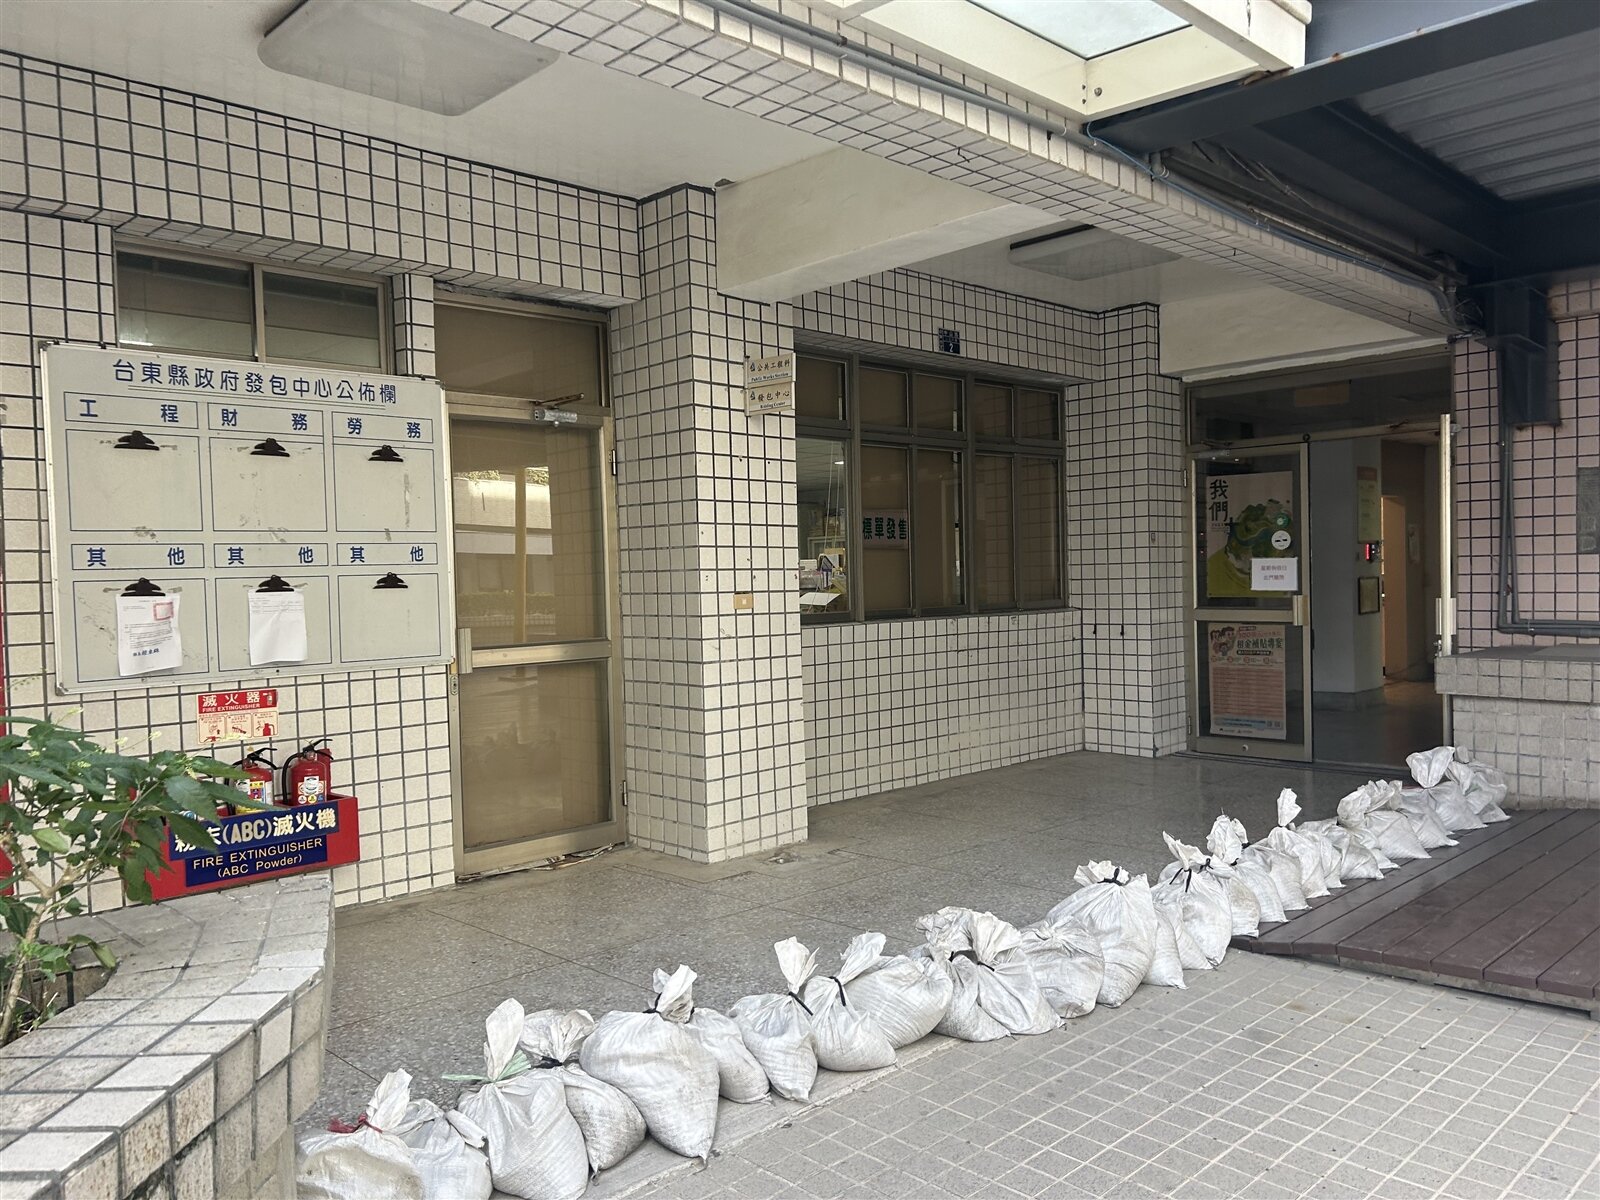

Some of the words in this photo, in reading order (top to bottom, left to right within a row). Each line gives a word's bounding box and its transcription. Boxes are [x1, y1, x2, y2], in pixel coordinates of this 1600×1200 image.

[112, 358, 398, 405] 台東縣政府發包中心公佈欄
[757, 390, 790, 402] 發包中心
[862, 517, 907, 540] 標單發售
[217, 703, 260, 712] EXTINGUISHER
[193, 855, 224, 869] FIRE
[230, 838, 323, 863] EXTINGUISHER
[218, 864, 249, 878] (ABC
[255, 854, 303, 871] Powder)
